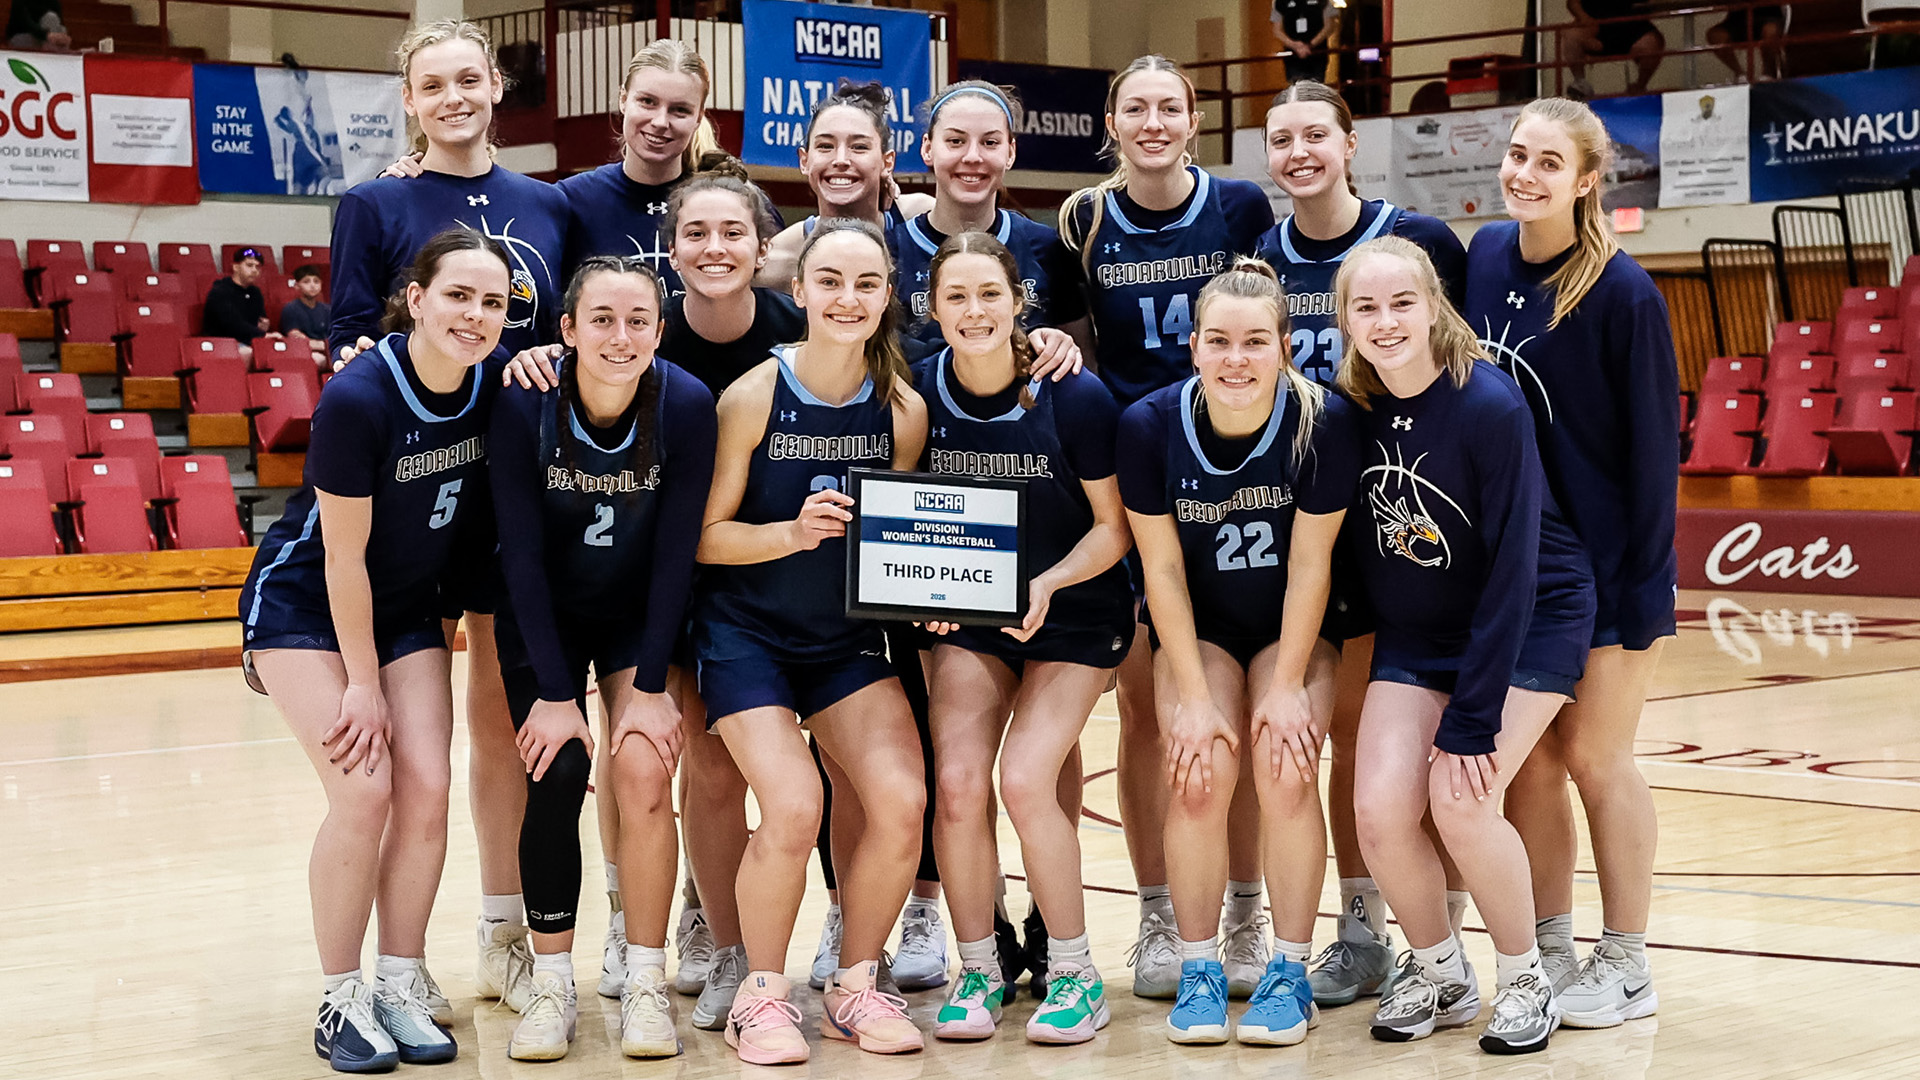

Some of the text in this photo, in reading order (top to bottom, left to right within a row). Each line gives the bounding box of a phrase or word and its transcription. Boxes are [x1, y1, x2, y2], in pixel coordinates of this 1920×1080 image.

[796, 20, 881, 59] NCCAA
[215, 105, 247, 119] STAY
[350, 113, 388, 124] SPORTS
[212, 122, 253, 137] IN THE
[25, 146, 80, 159] SERVICE
[211, 139, 254, 154] GAME.
[1097, 251, 1226, 289] CEDARVILLE
[1139, 293, 1194, 350] 14
[1290, 328, 1343, 384] 23
[768, 432, 890, 461] CEDARVILLE
[929, 447, 1053, 479] CEDARVILLE
[429, 478, 463, 529] 5
[914, 491, 965, 511] NCCAA
[584, 503, 614, 546] 2
[881, 530, 997, 548] WOMEN'S BASKETBALL
[913, 522, 965, 535] DIVISION I
[1215, 521, 1279, 571] 22
[1704, 521, 1860, 585] Cats
[882, 562, 993, 584] THIRD PLACE
